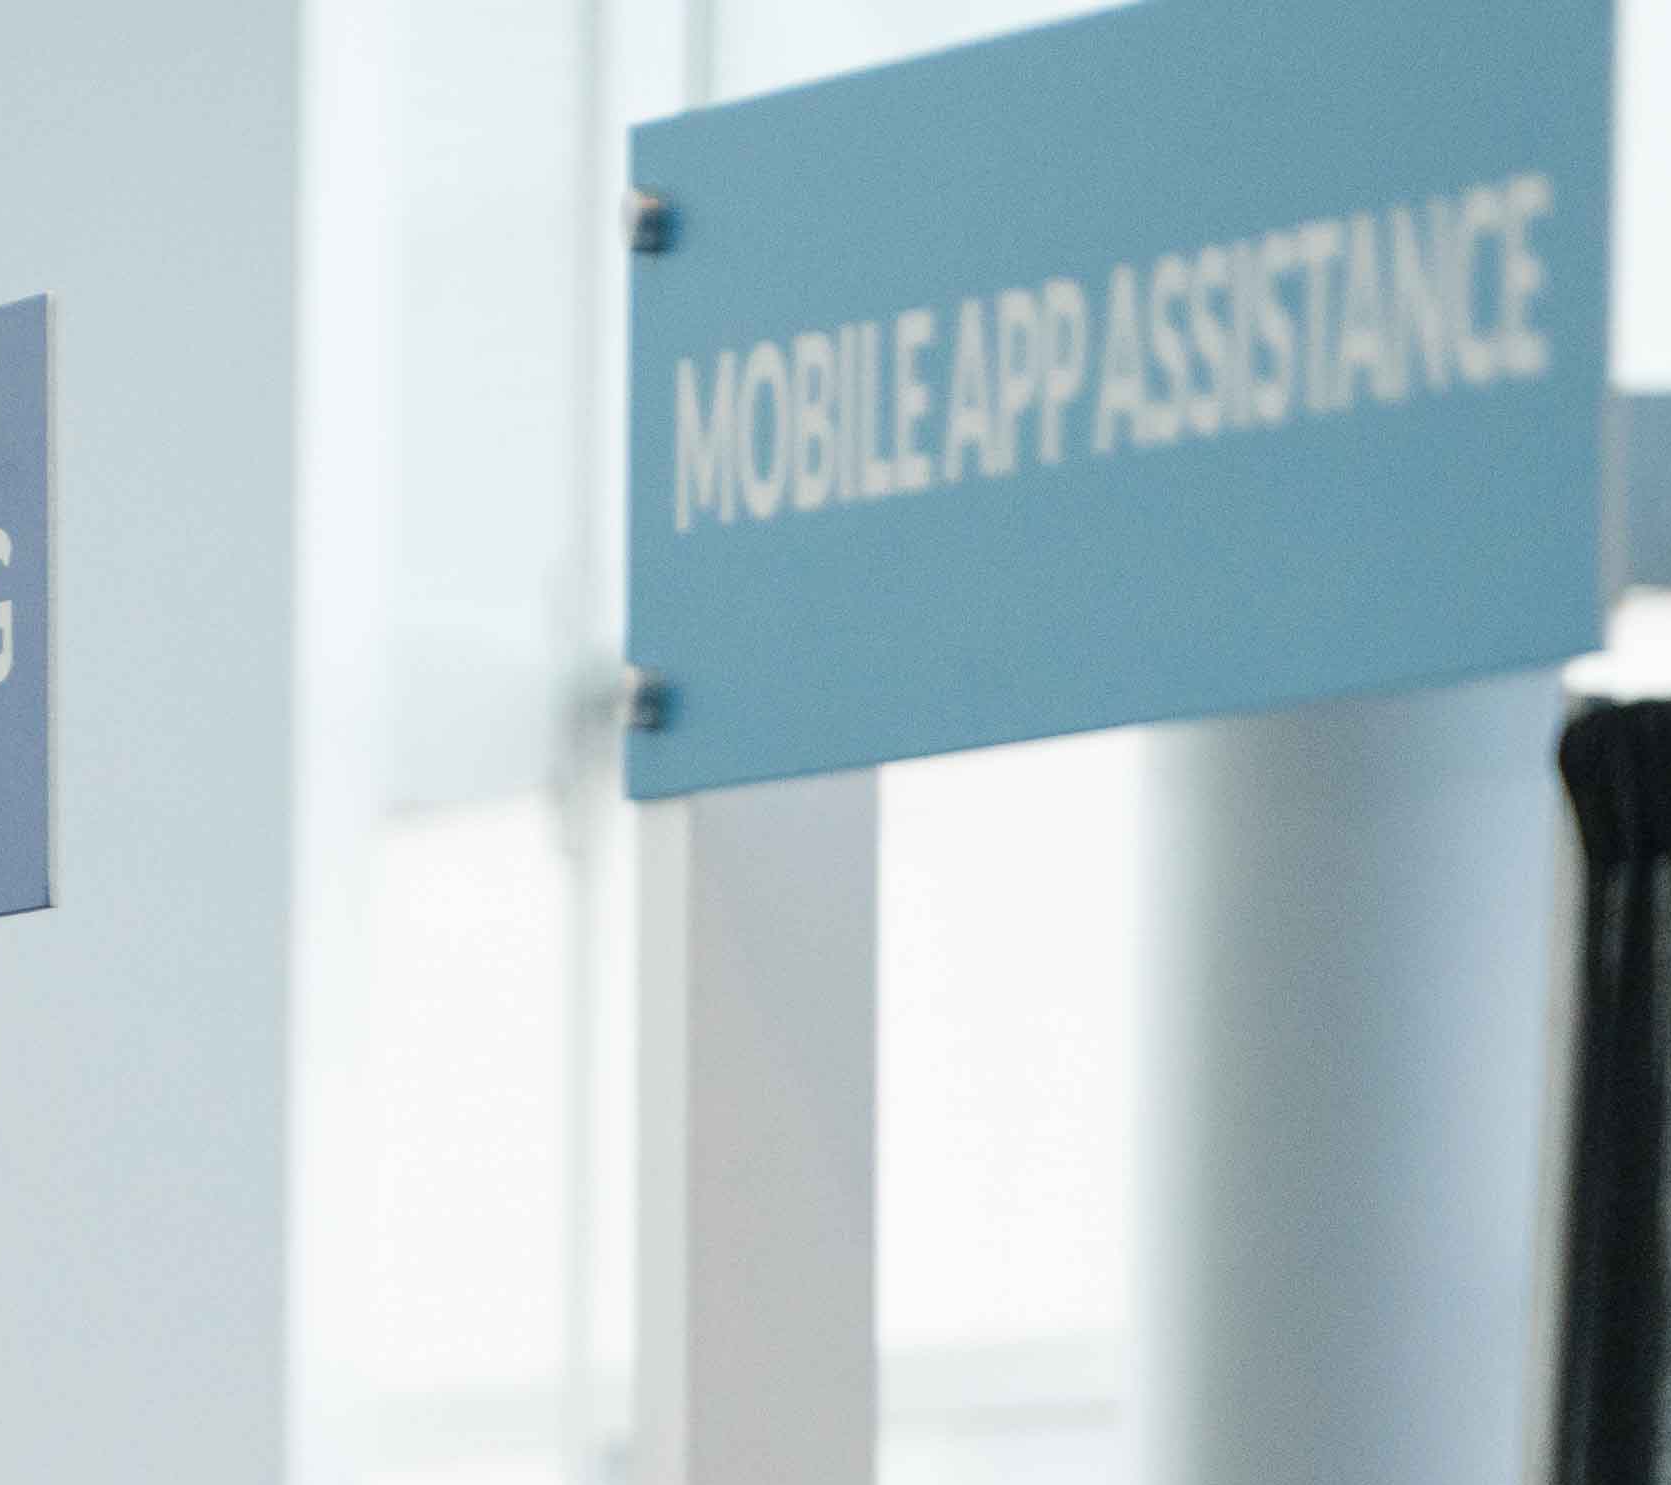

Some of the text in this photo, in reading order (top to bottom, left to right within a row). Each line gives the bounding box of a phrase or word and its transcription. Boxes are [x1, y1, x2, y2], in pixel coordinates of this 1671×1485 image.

[673, 172, 1553, 533] MOBILE APP ASSISTANCE
